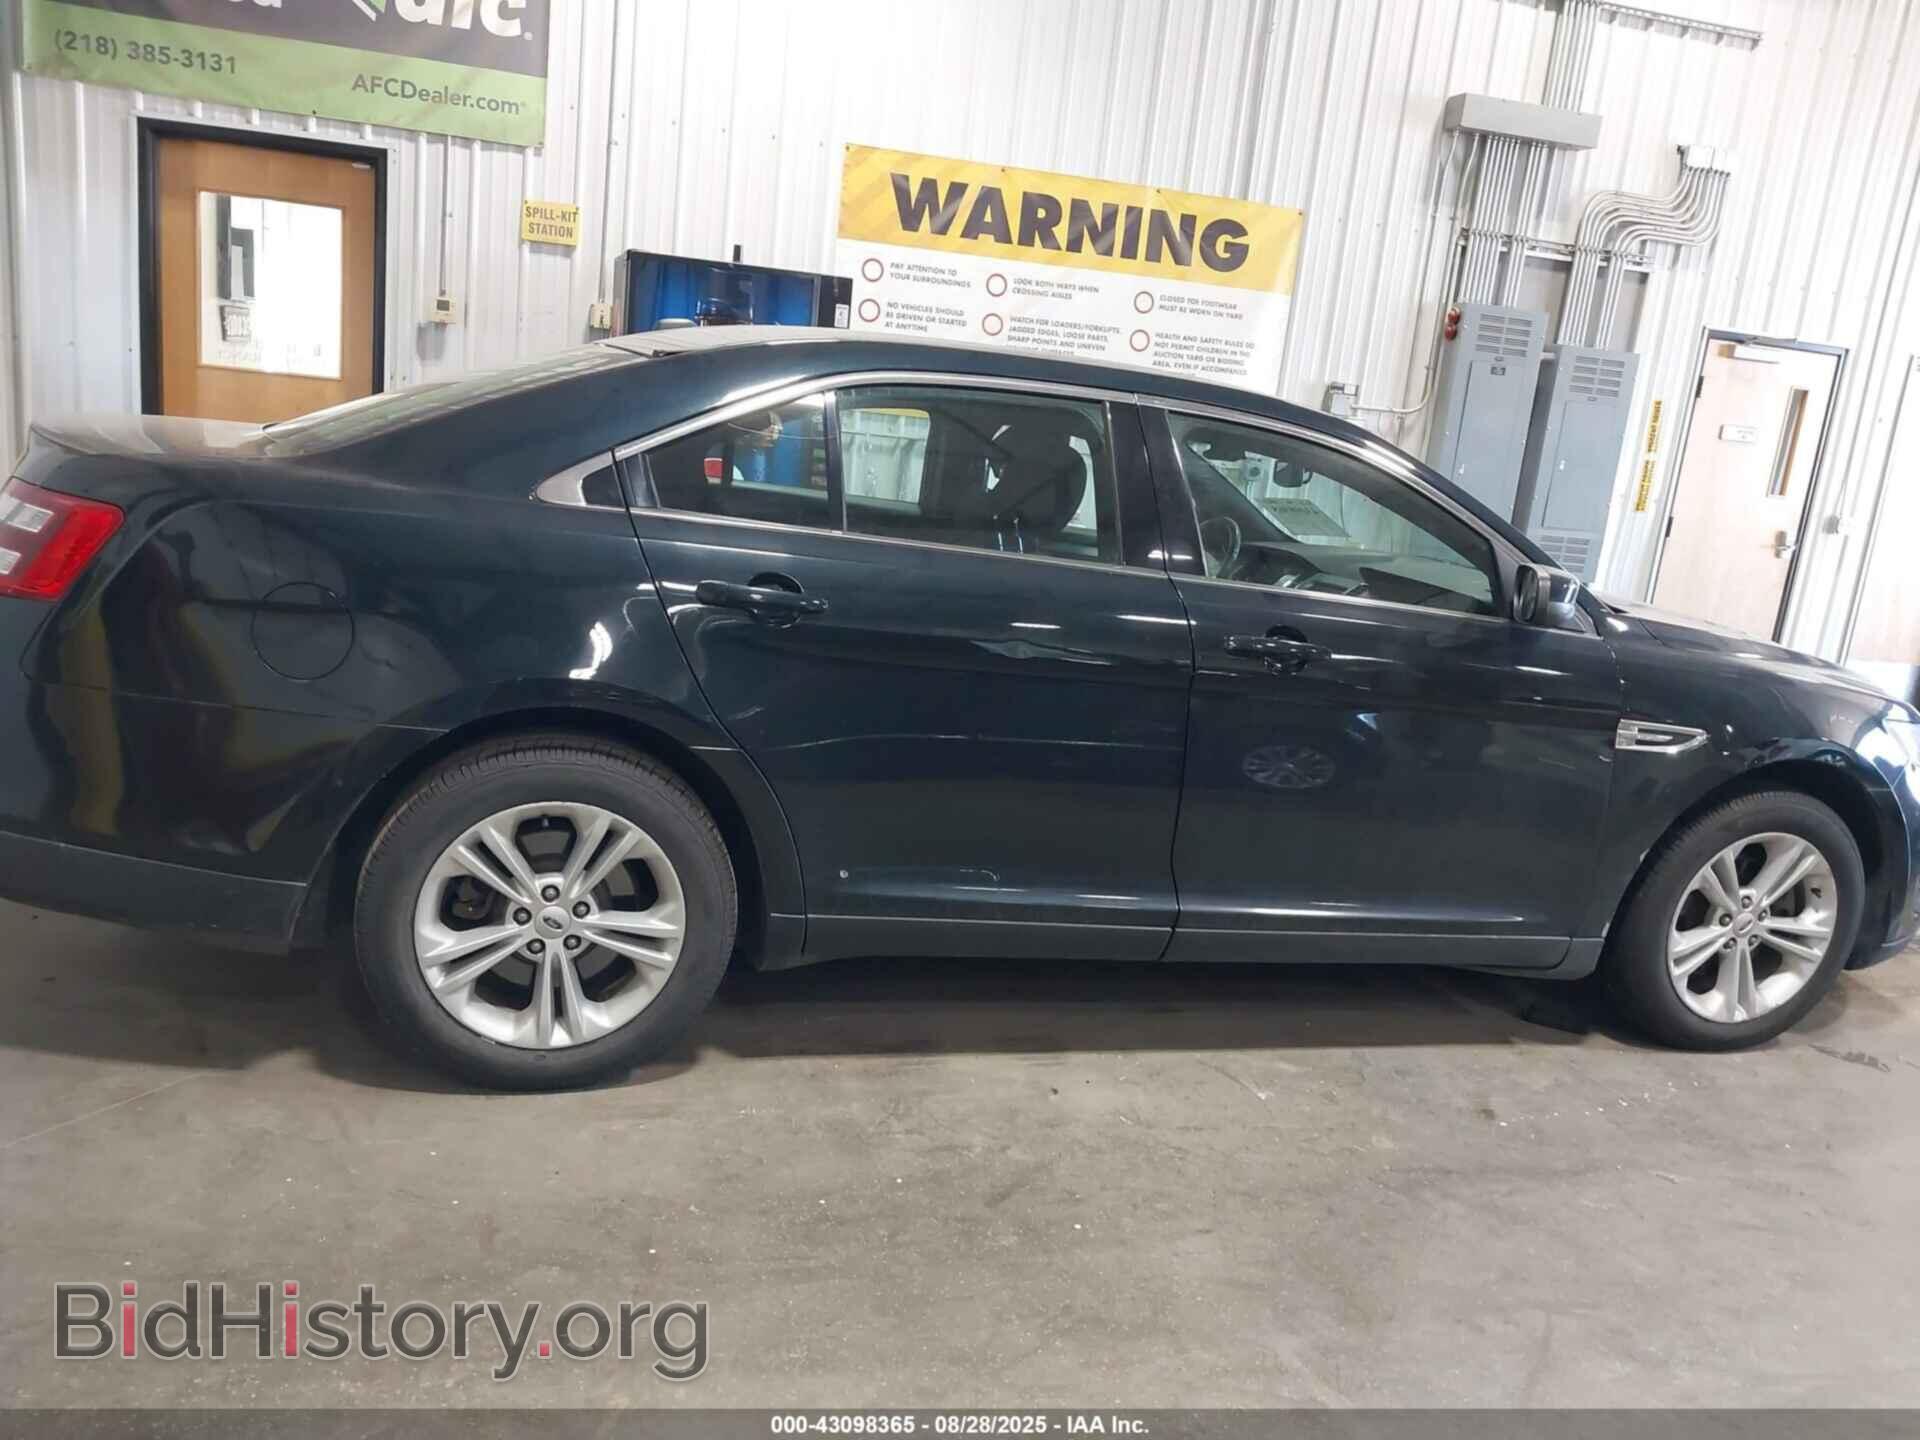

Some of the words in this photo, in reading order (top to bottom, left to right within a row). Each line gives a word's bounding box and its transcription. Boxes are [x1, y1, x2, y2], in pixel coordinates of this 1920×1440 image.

[55, 30, 117, 60] (218)
[127, 41, 236, 74] 385-3131
[351, 74, 519, 115] AFCDealer.com
[525, 206, 577, 223] SPILL-KIT
[890, 173, 1249, 272] WARNING
[528, 222, 573, 239] STATION
[890, 272, 910, 280] YOUR
